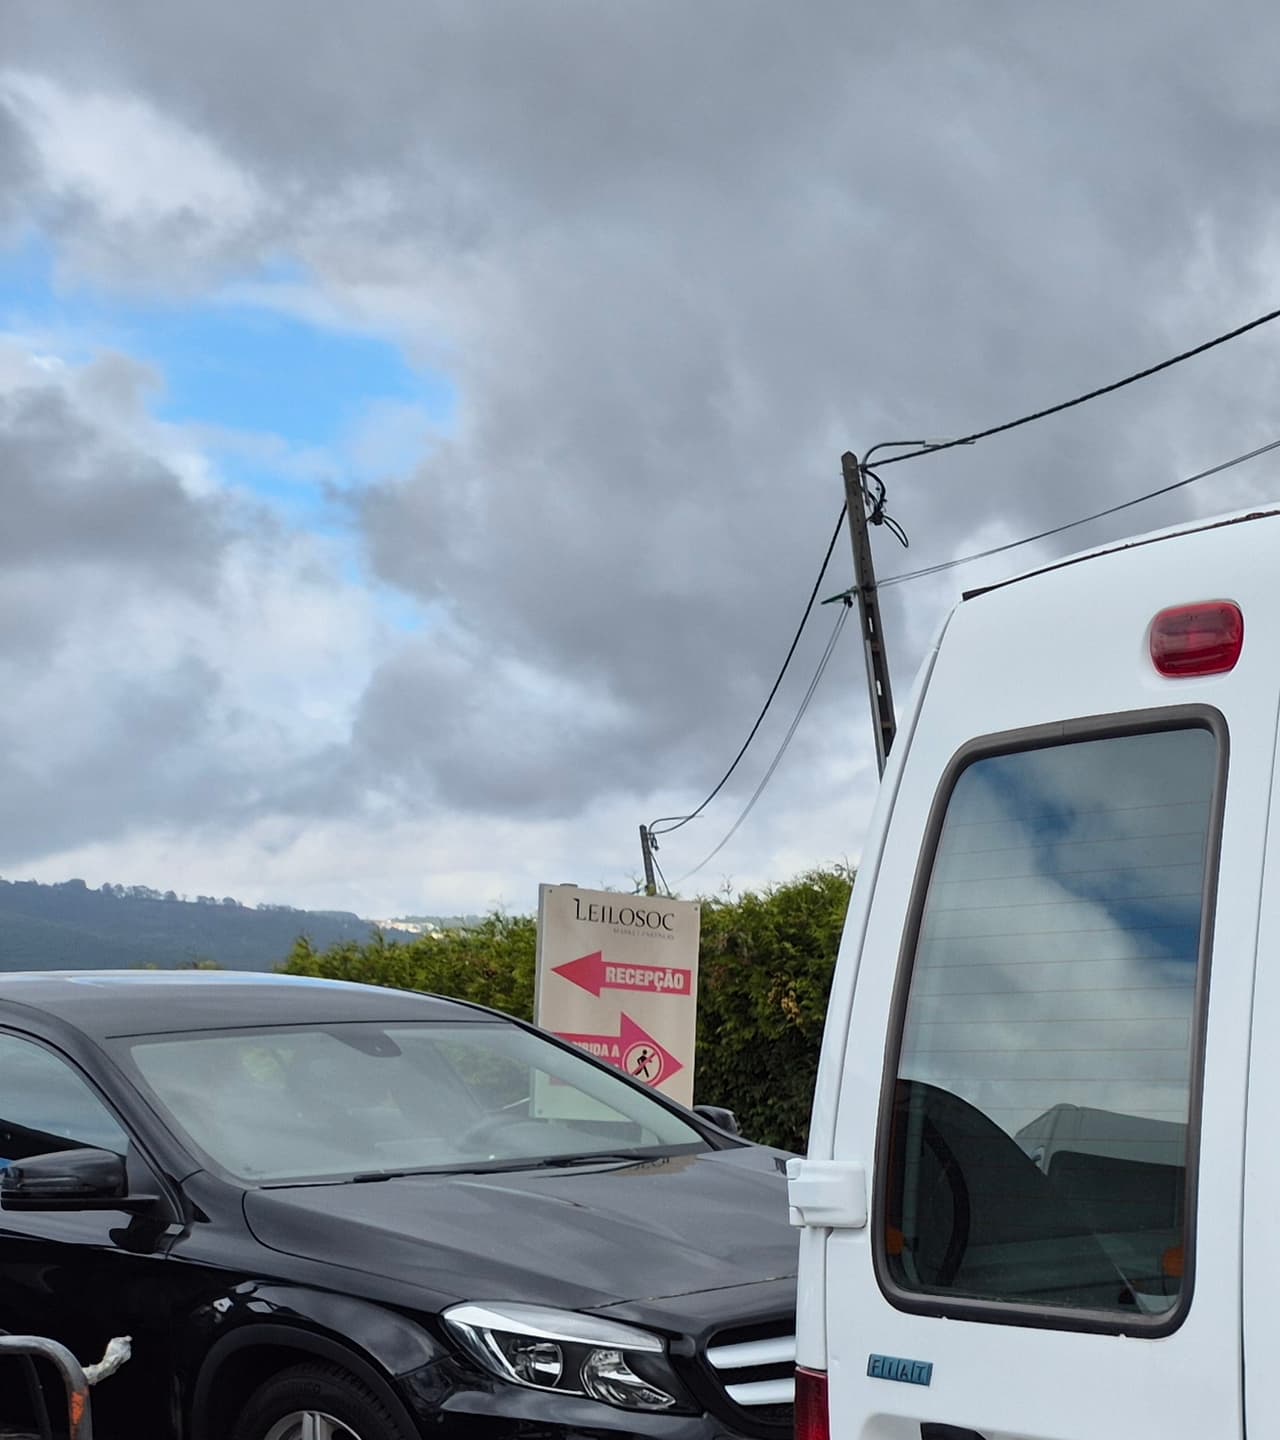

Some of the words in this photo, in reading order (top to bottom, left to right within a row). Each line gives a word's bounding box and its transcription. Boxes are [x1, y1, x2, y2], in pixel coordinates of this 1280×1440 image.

[574, 898, 675, 931] LEILOSOC
[606, 967, 684, 991] RECEPÇÃO
[870, 1357, 930, 1384] FIAT
